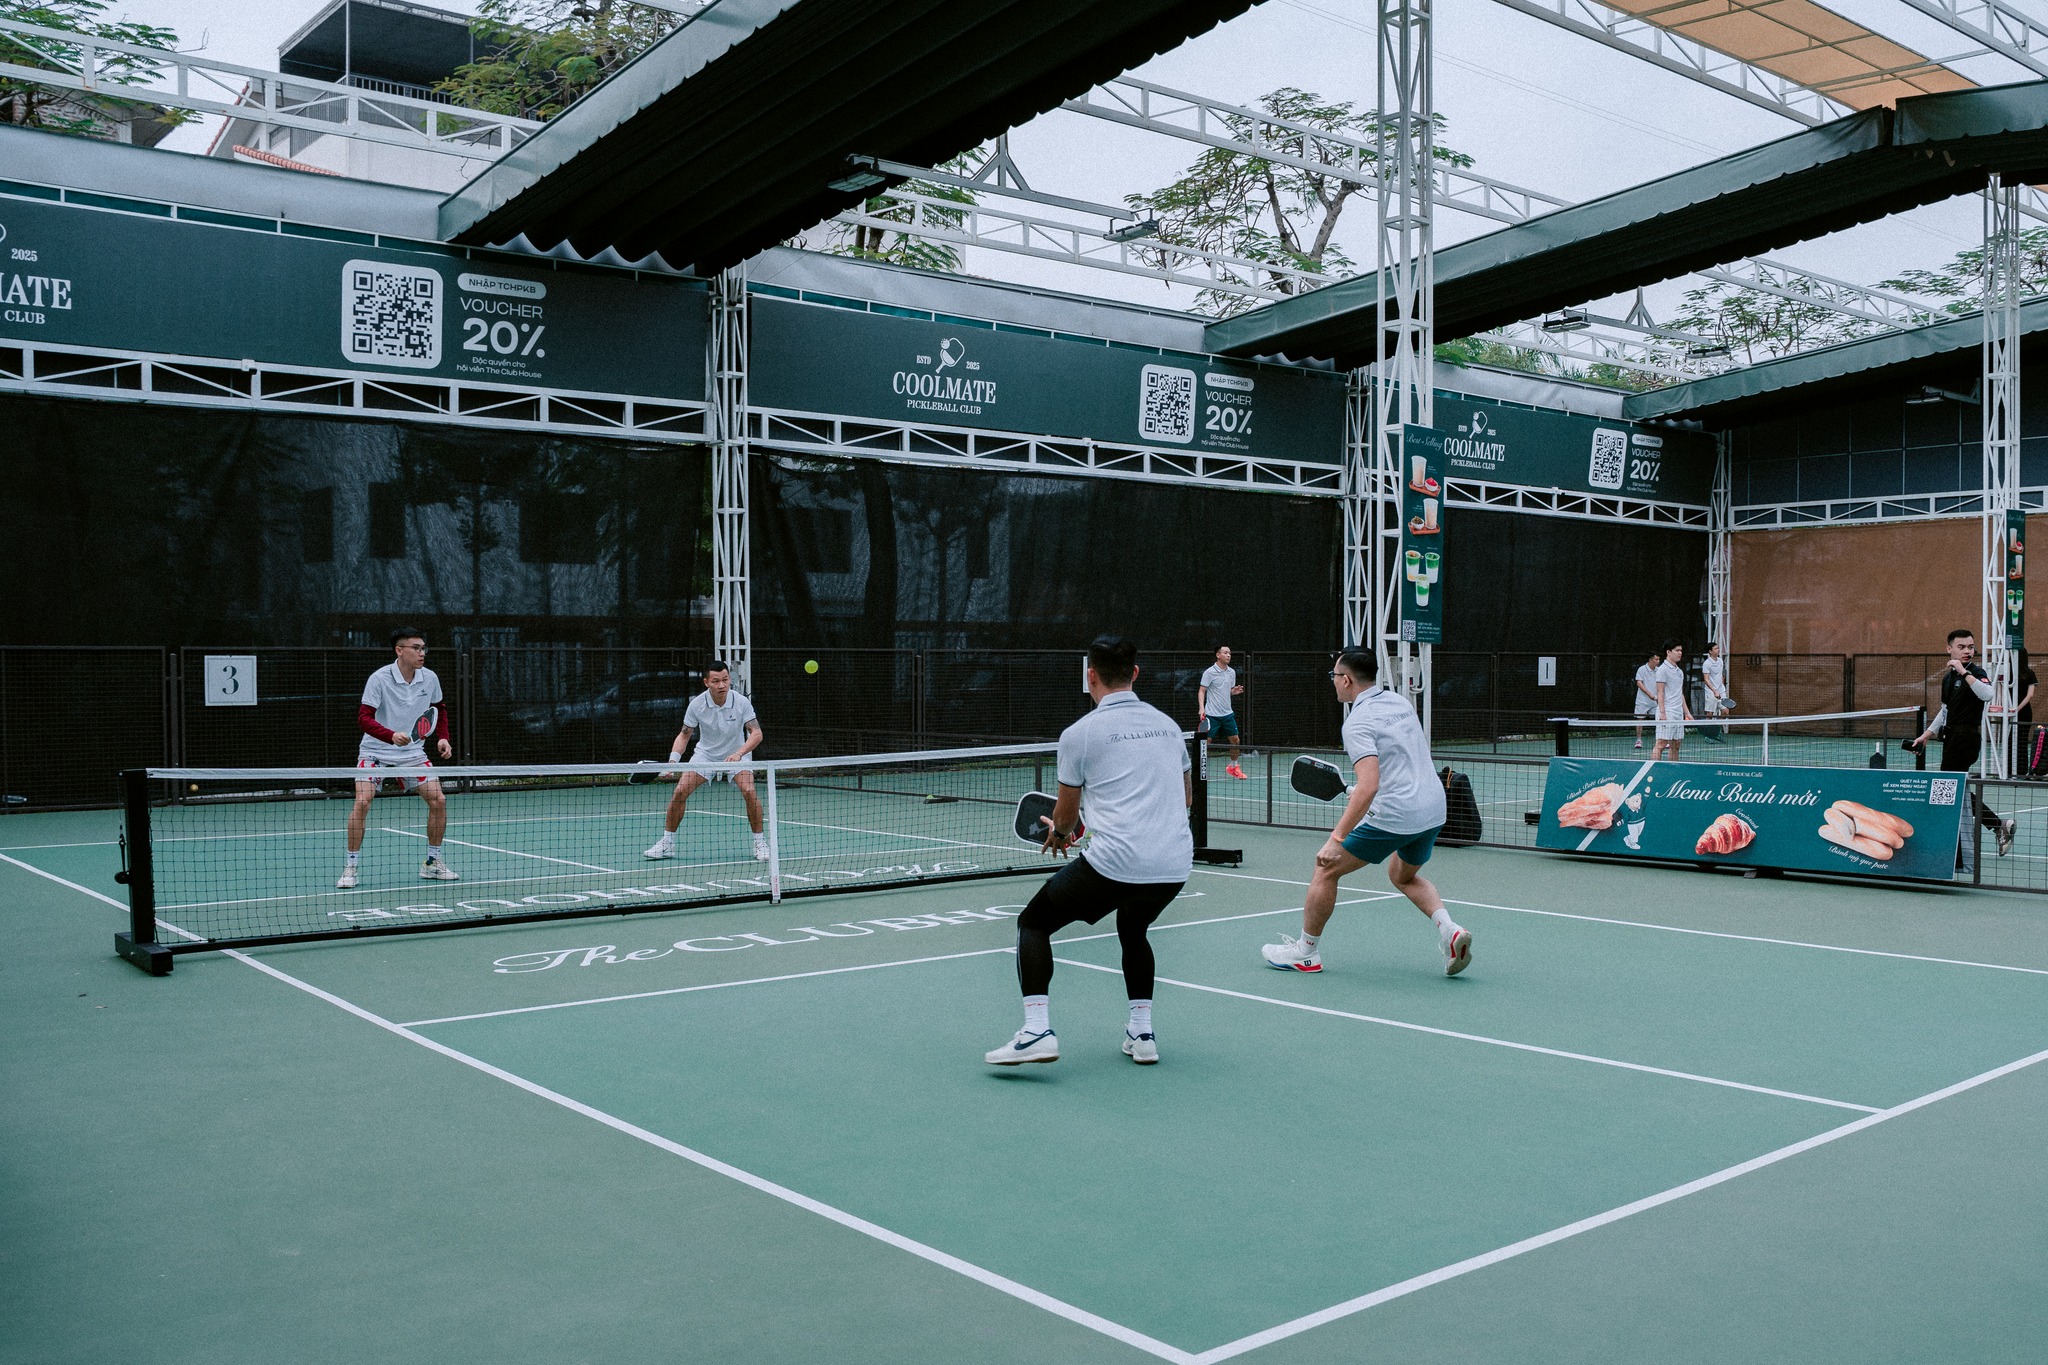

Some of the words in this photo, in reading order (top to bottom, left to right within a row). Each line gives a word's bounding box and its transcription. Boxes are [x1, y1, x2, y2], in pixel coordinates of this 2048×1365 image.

[11, 248, 38, 262] 2025
[468, 278, 496, 290] NHẬP
[498, 282, 536, 294] TCHPKB
[4, 309, 46, 325] CLUB
[460, 297, 543, 319] VOUCHER
[463, 317, 546, 358] 20%
[486, 367, 500, 375] The
[501, 368, 518, 377] Club
[519, 370, 542, 379] House
[512, 360, 527, 368] cho
[893, 371, 997, 404] COOLMATE
[907, 399, 959, 413] PICKLEBALL
[960, 404, 982, 415] CLUB
[1205, 390, 1252, 406] VOUCHER
[1205, 405, 1253, 435] 20%
[1444, 436, 1506, 462] COOLMATE
[1632, 447, 1661, 459] VOUCHER
[1451, 458, 1482, 469] PICKLEBALL
[1482, 462, 1496, 471] CLUB
[1630, 459, 1661, 482] 20%
[222, 665, 239, 695] 3
[1655, 779, 1715, 801] Menu
[1717, 782, 1777, 804] Bánh
[1778, 789, 1822, 807] mới
[493, 945, 674, 974] The
